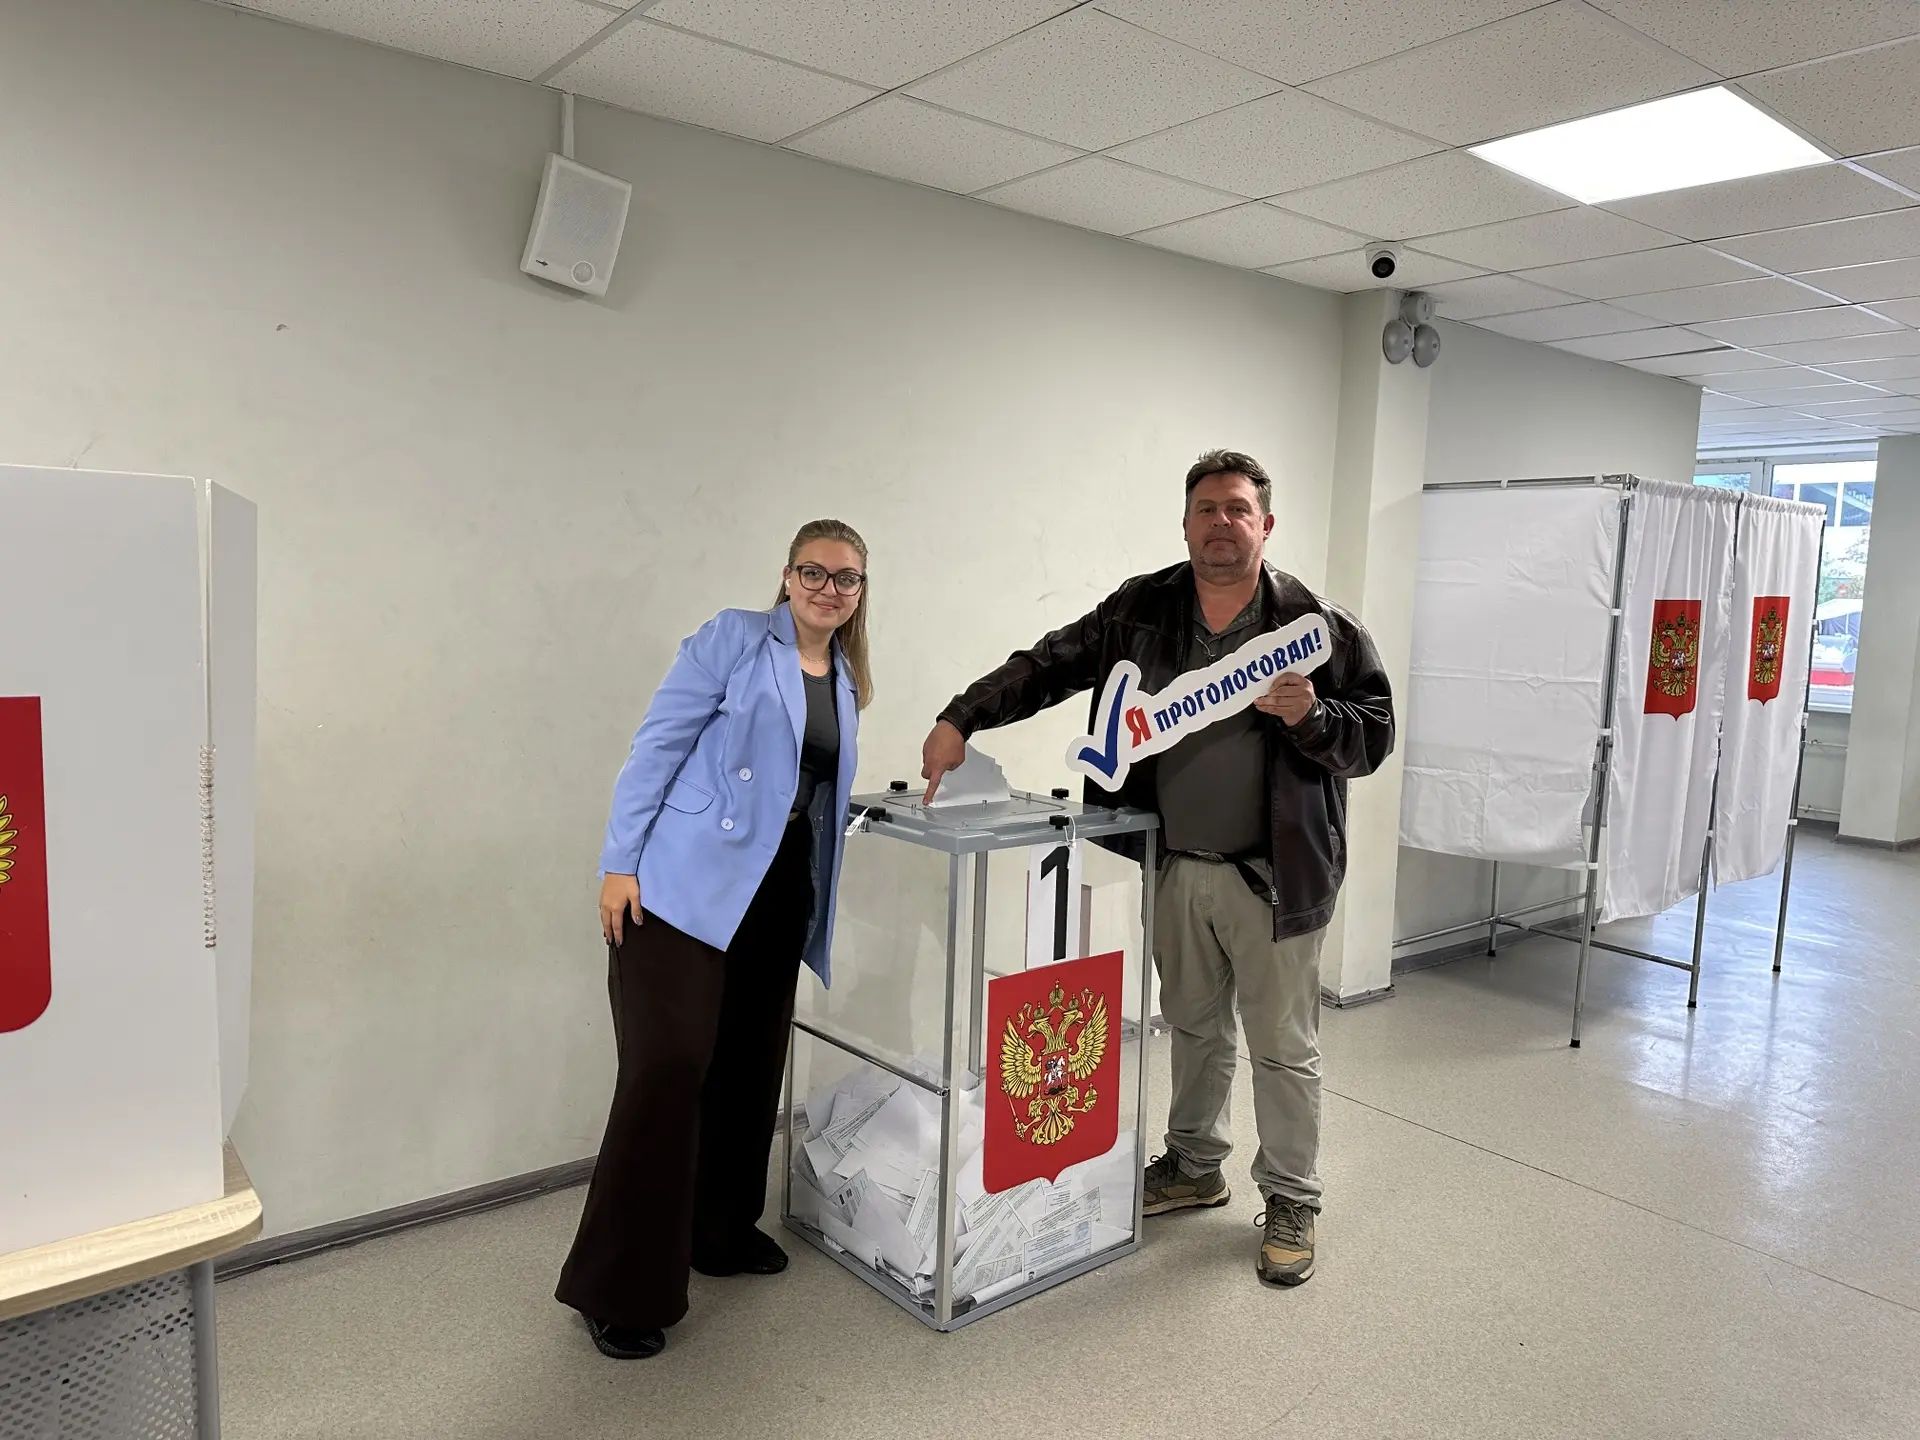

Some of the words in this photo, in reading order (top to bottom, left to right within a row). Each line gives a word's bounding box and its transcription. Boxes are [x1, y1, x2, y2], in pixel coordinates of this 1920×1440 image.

[1125, 705, 1153, 749] Я
[1153, 627, 1323, 733] ПРОГОЛОСОВАЛ!
[1040, 845, 1070, 961] 1
